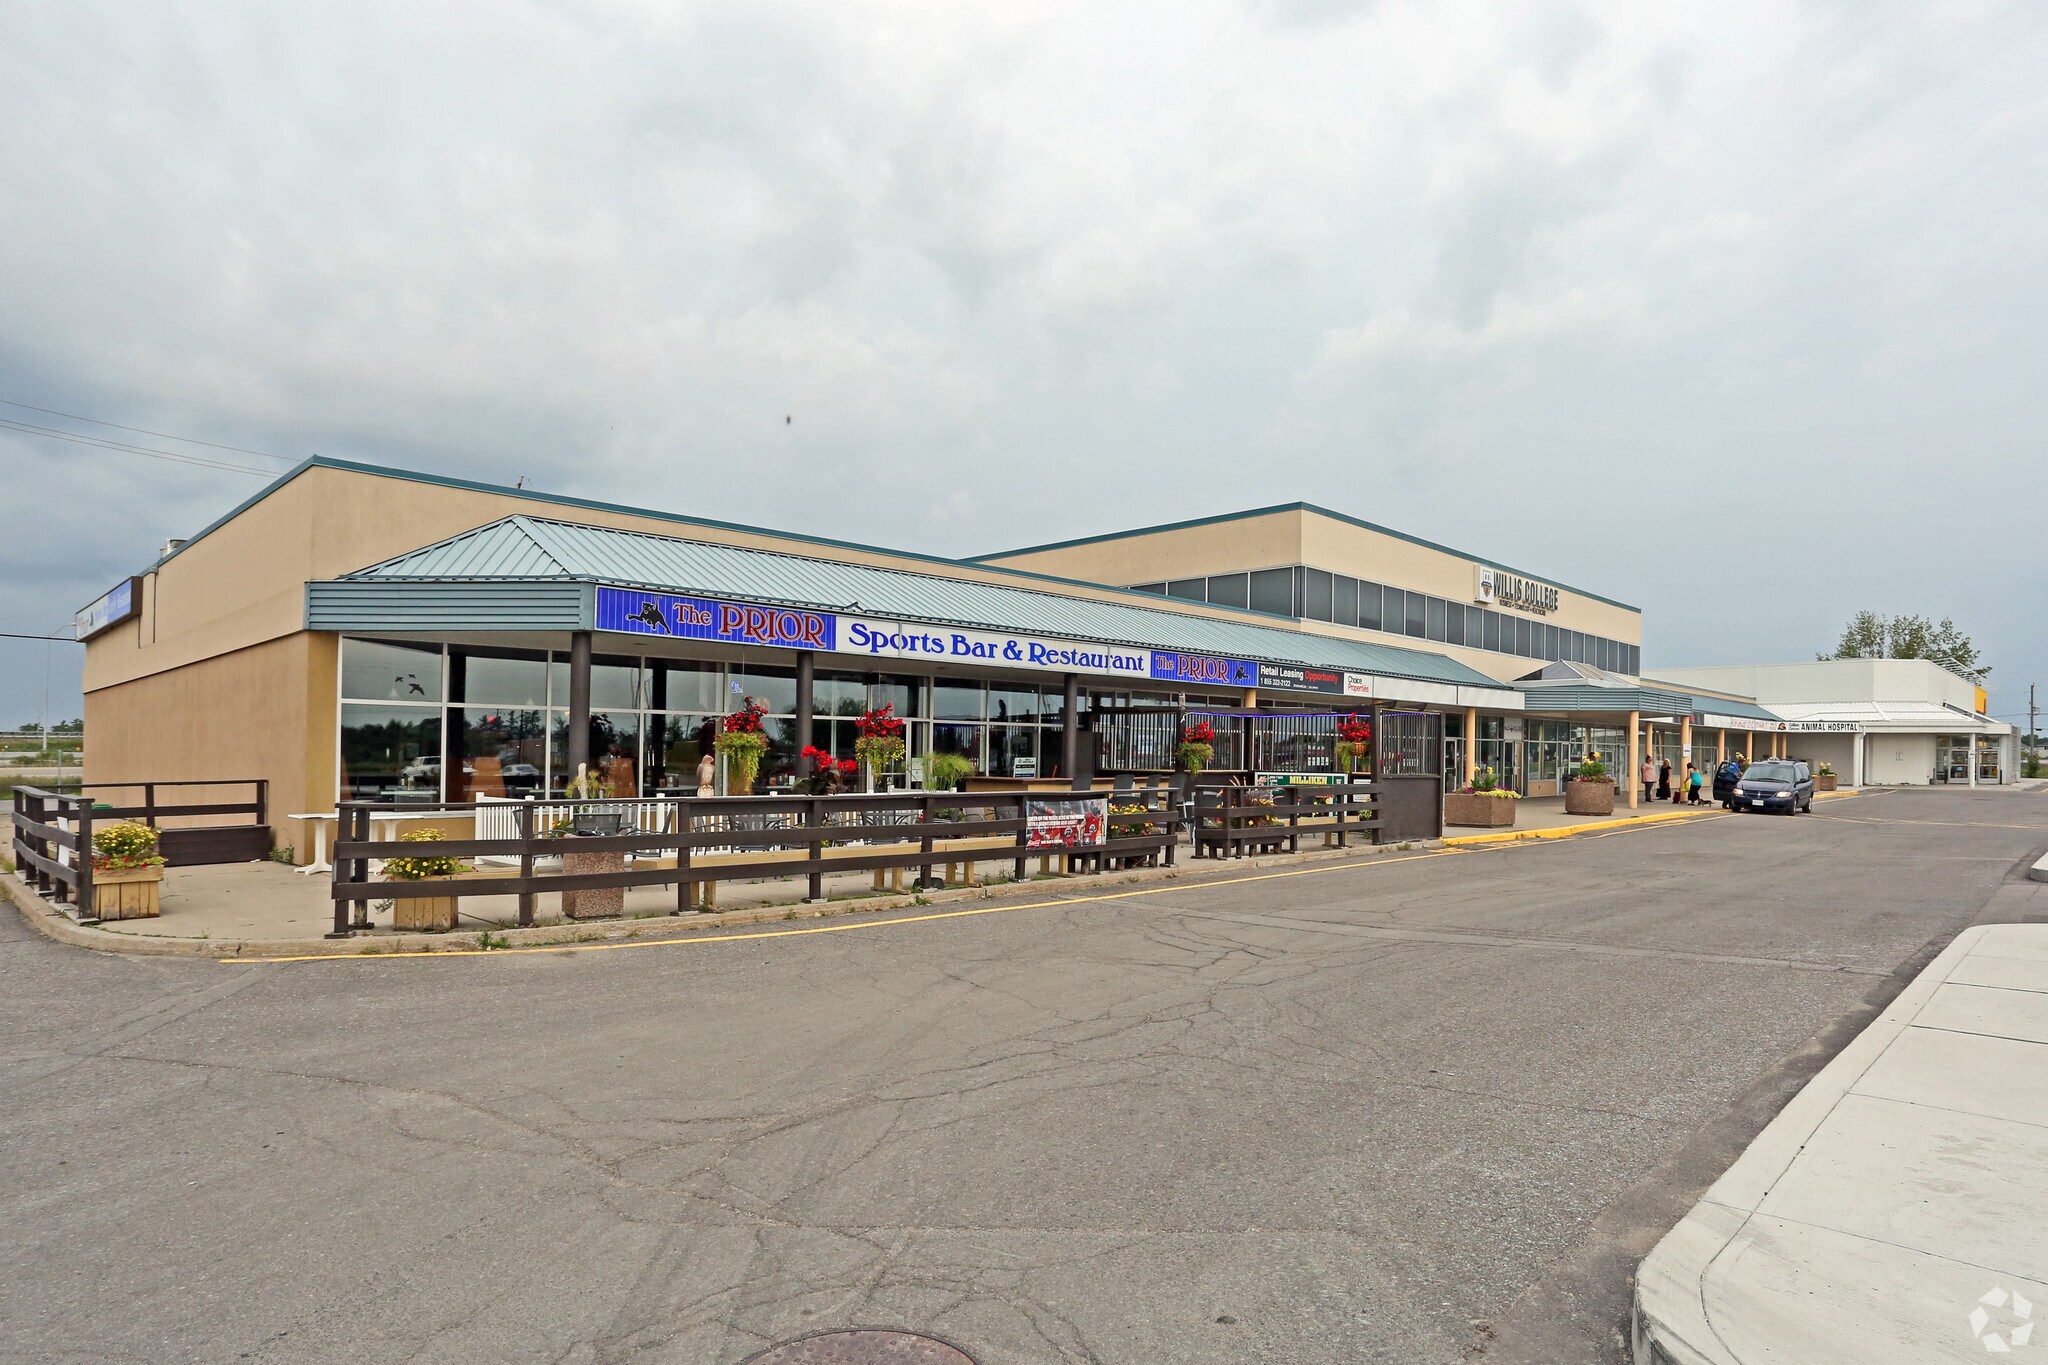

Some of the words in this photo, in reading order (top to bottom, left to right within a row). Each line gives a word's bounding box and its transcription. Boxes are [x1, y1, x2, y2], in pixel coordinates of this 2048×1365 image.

[1493, 571, 1522, 600] WILLIS
[1524, 581, 1558, 610] COLLEGE
[672, 602, 712, 625] The
[718, 603, 827, 648] PRIOR
[848, 623, 945, 654] Sports
[950, 634, 998, 659] Bar
[1002, 640, 1023, 661] &
[1027, 642, 1145, 671] Restaurant
[1156, 655, 1175, 670] The
[1177, 655, 1229, 683] PRIOR
[1260, 665, 1279, 677] Retail
[1279, 667, 1304, 681] Leasing
[1304, 670, 1339, 685] Opportunity
[1347, 683, 1369, 693] Properties
[1801, 723, 1826, 731] ANIMAL
[1827, 723, 1858, 731] HOSPITAL
[1289, 775, 1328, 785] MILLIKEN
